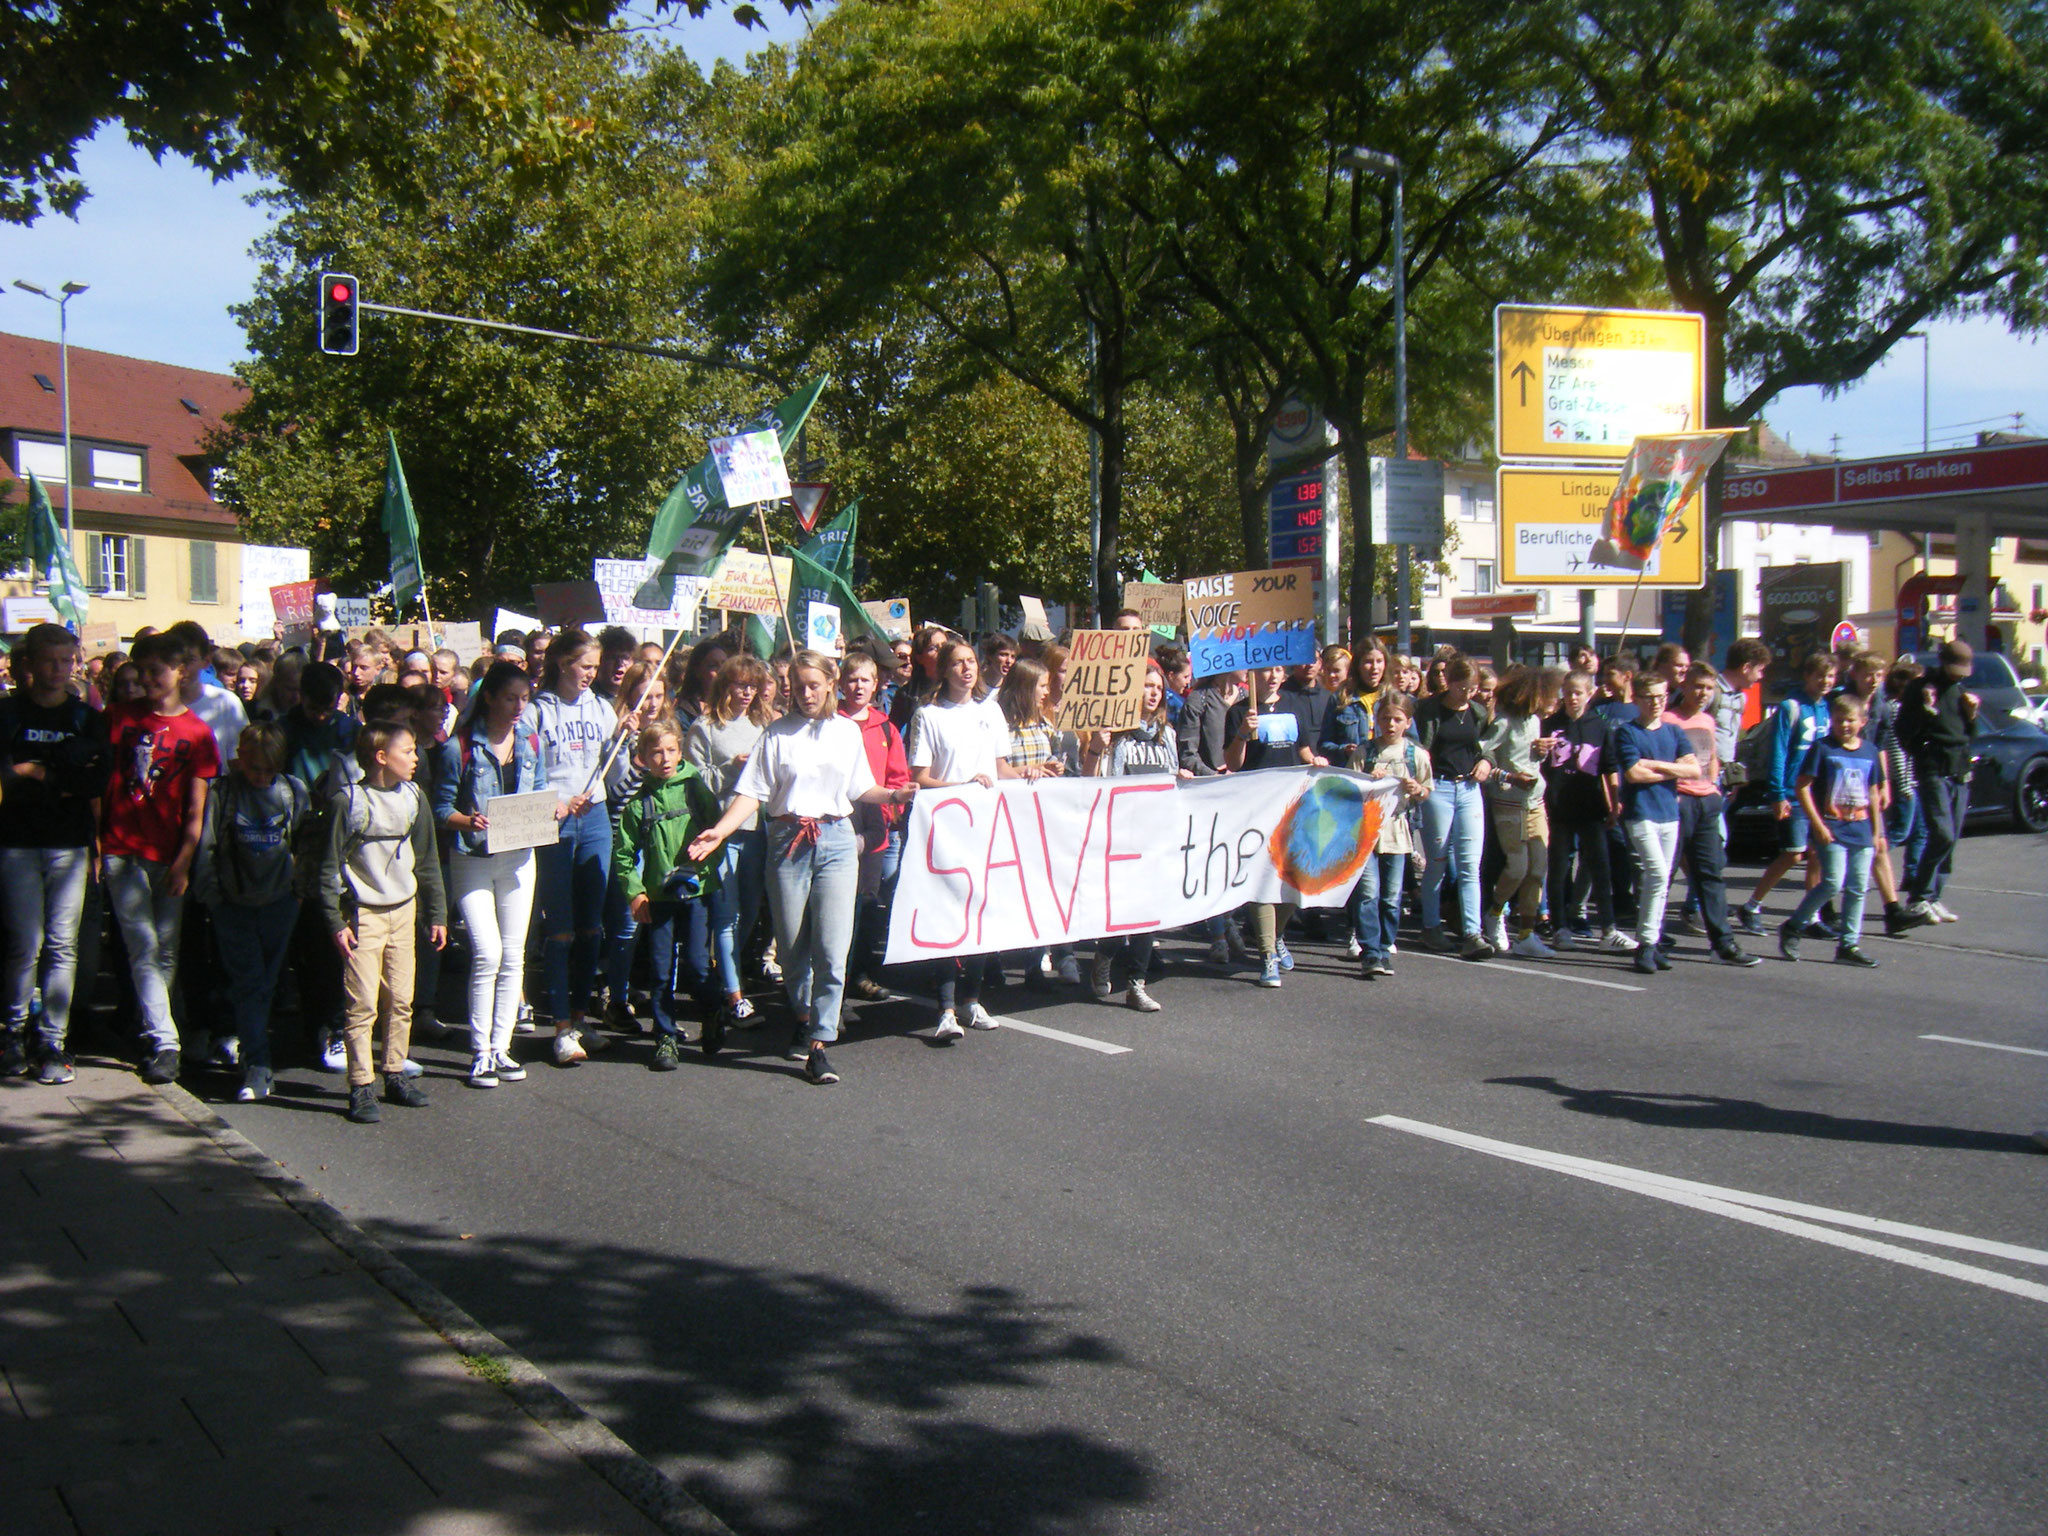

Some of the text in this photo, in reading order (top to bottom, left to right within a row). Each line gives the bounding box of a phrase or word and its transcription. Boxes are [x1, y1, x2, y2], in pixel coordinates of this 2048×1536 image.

[1542, 322, 1622, 347] Überlingen
[1548, 354, 1594, 369] Messe
[1548, 375, 1566, 390] ZF
[1843, 460, 1972, 488] Selbst Tanken
[1562, 481, 1610, 497] Lindau
[819, 531, 849, 545] FRID
[1520, 529, 1593, 545] Berufliche
[1185, 573, 1297, 601] RAISE YOUR
[717, 592, 787, 614] ZUKUNFT
[1141, 597, 1164, 609] NOT
[1188, 601, 1242, 629] VOICE
[1219, 617, 1306, 643] NOT THE
[1071, 632, 1150, 661] NOCH IST
[1201, 635, 1292, 672] Sea level
[1064, 663, 1134, 696] ALLES
[1057, 698, 1138, 730] MÖGLICH
[911, 783, 1265, 950] SAVE the
